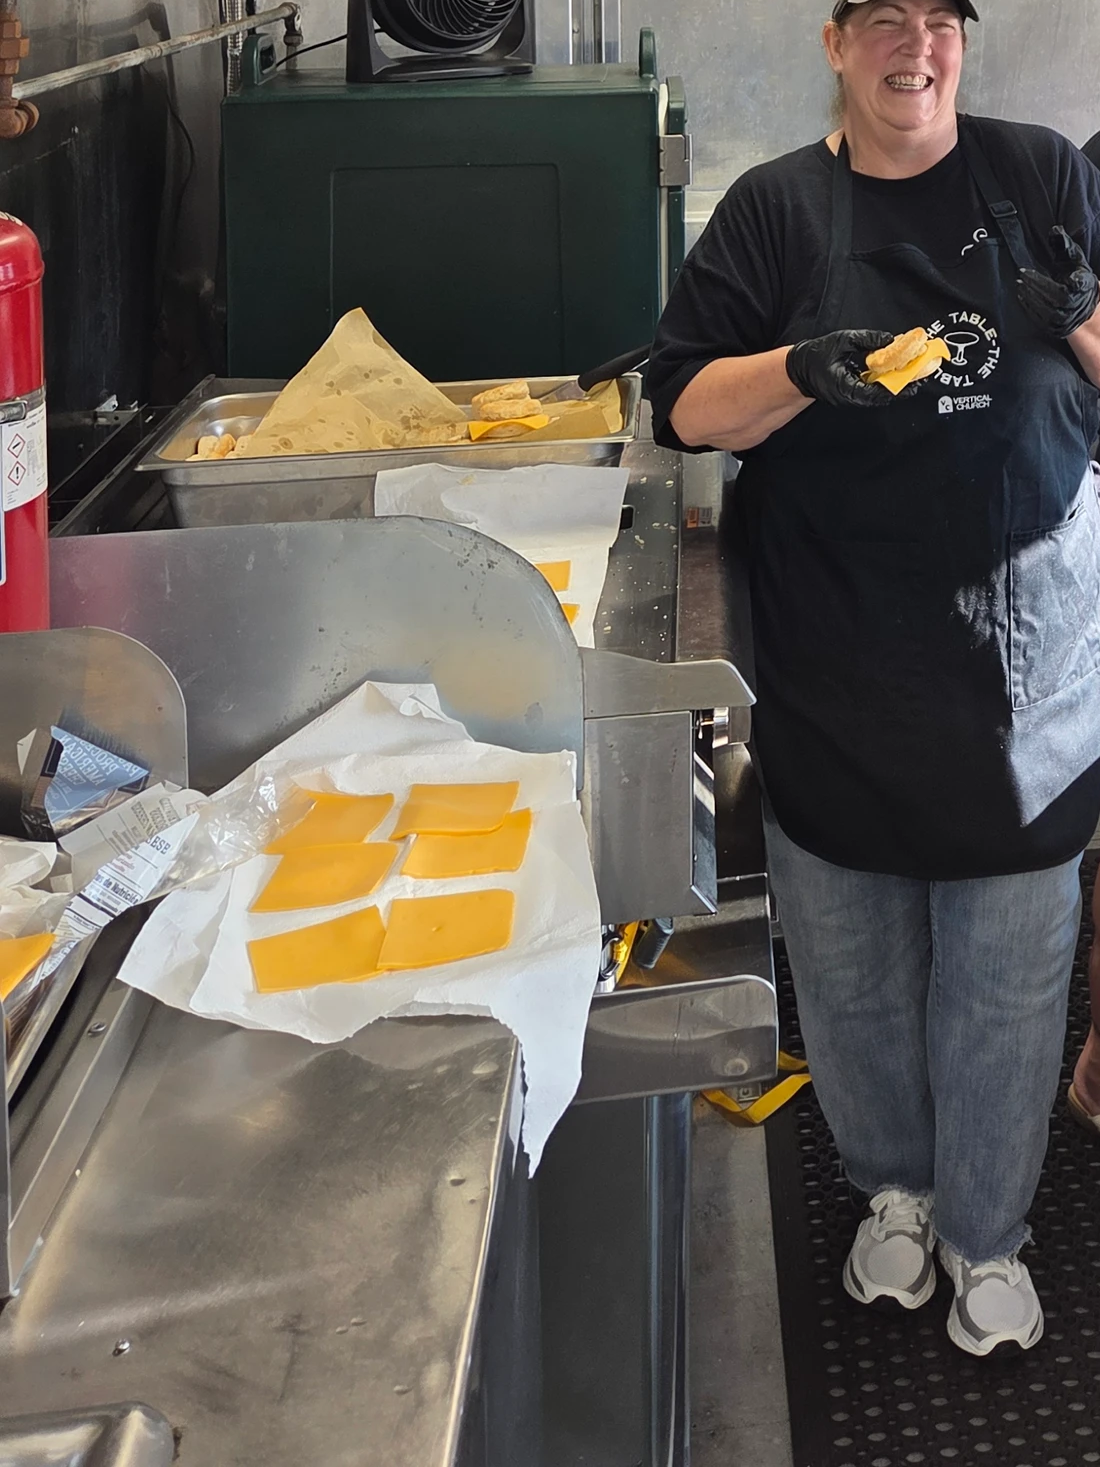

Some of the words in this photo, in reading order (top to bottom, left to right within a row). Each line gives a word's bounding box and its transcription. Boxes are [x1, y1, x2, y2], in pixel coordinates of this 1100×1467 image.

[926, 319, 945, 339] HE
[933, 367, 974, 387] TABL
[953, 394, 992, 404] VERTICAL
[956, 401, 990, 411] CHURCH
[103, 877, 113, 889] de
